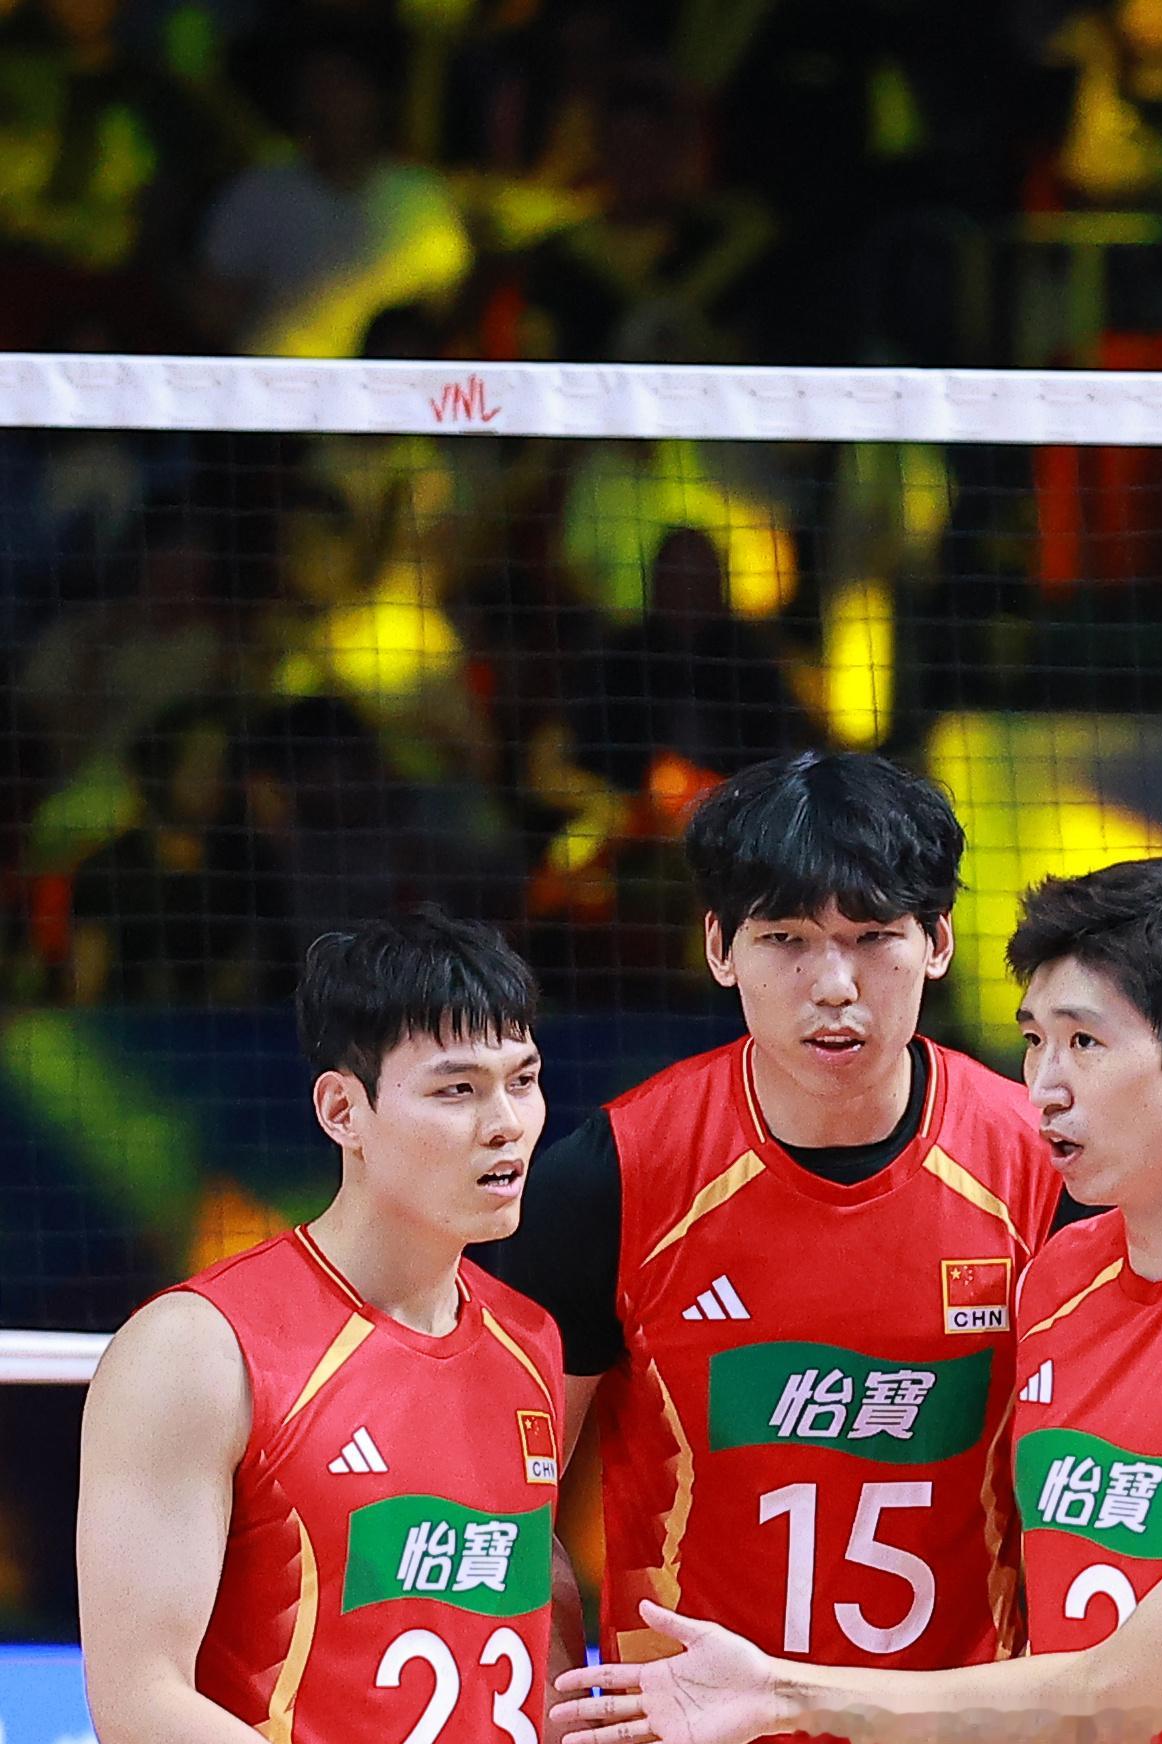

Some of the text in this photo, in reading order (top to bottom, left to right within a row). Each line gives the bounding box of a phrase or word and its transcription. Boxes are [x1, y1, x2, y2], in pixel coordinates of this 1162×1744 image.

[429, 374, 502, 423] VNL
[954, 1310, 1002, 1328] CHN
[771, 1370, 936, 1439] 怡寶
[397, 1521, 519, 1593] 怡寶
[759, 1482, 936, 1655] 15
